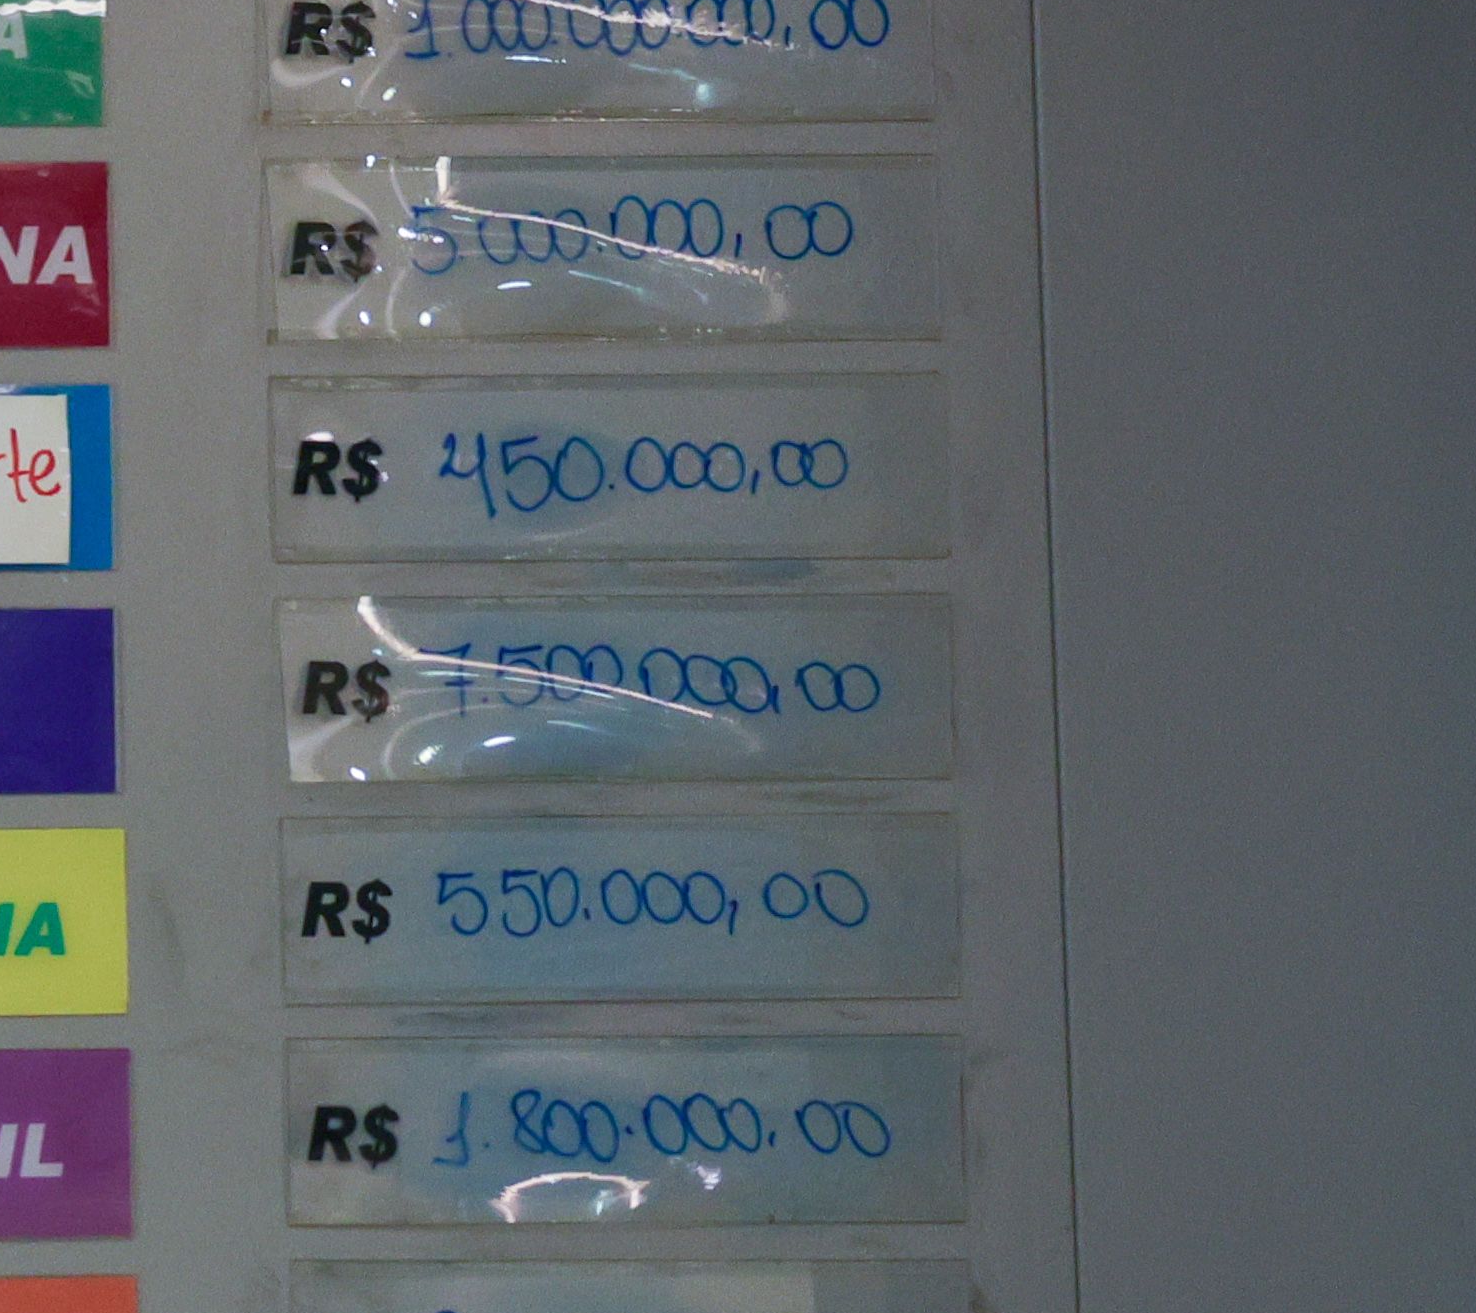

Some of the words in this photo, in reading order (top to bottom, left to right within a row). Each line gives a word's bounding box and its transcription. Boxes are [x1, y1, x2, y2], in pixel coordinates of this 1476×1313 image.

[285, 1, 375, 64] R$
[290, 221, 380, 284] R$
[291, 438, 384, 503] R$
[301, 660, 392, 723] R$
[301, 878, 393, 944] R$
[307, 1104, 401, 1169] R$
